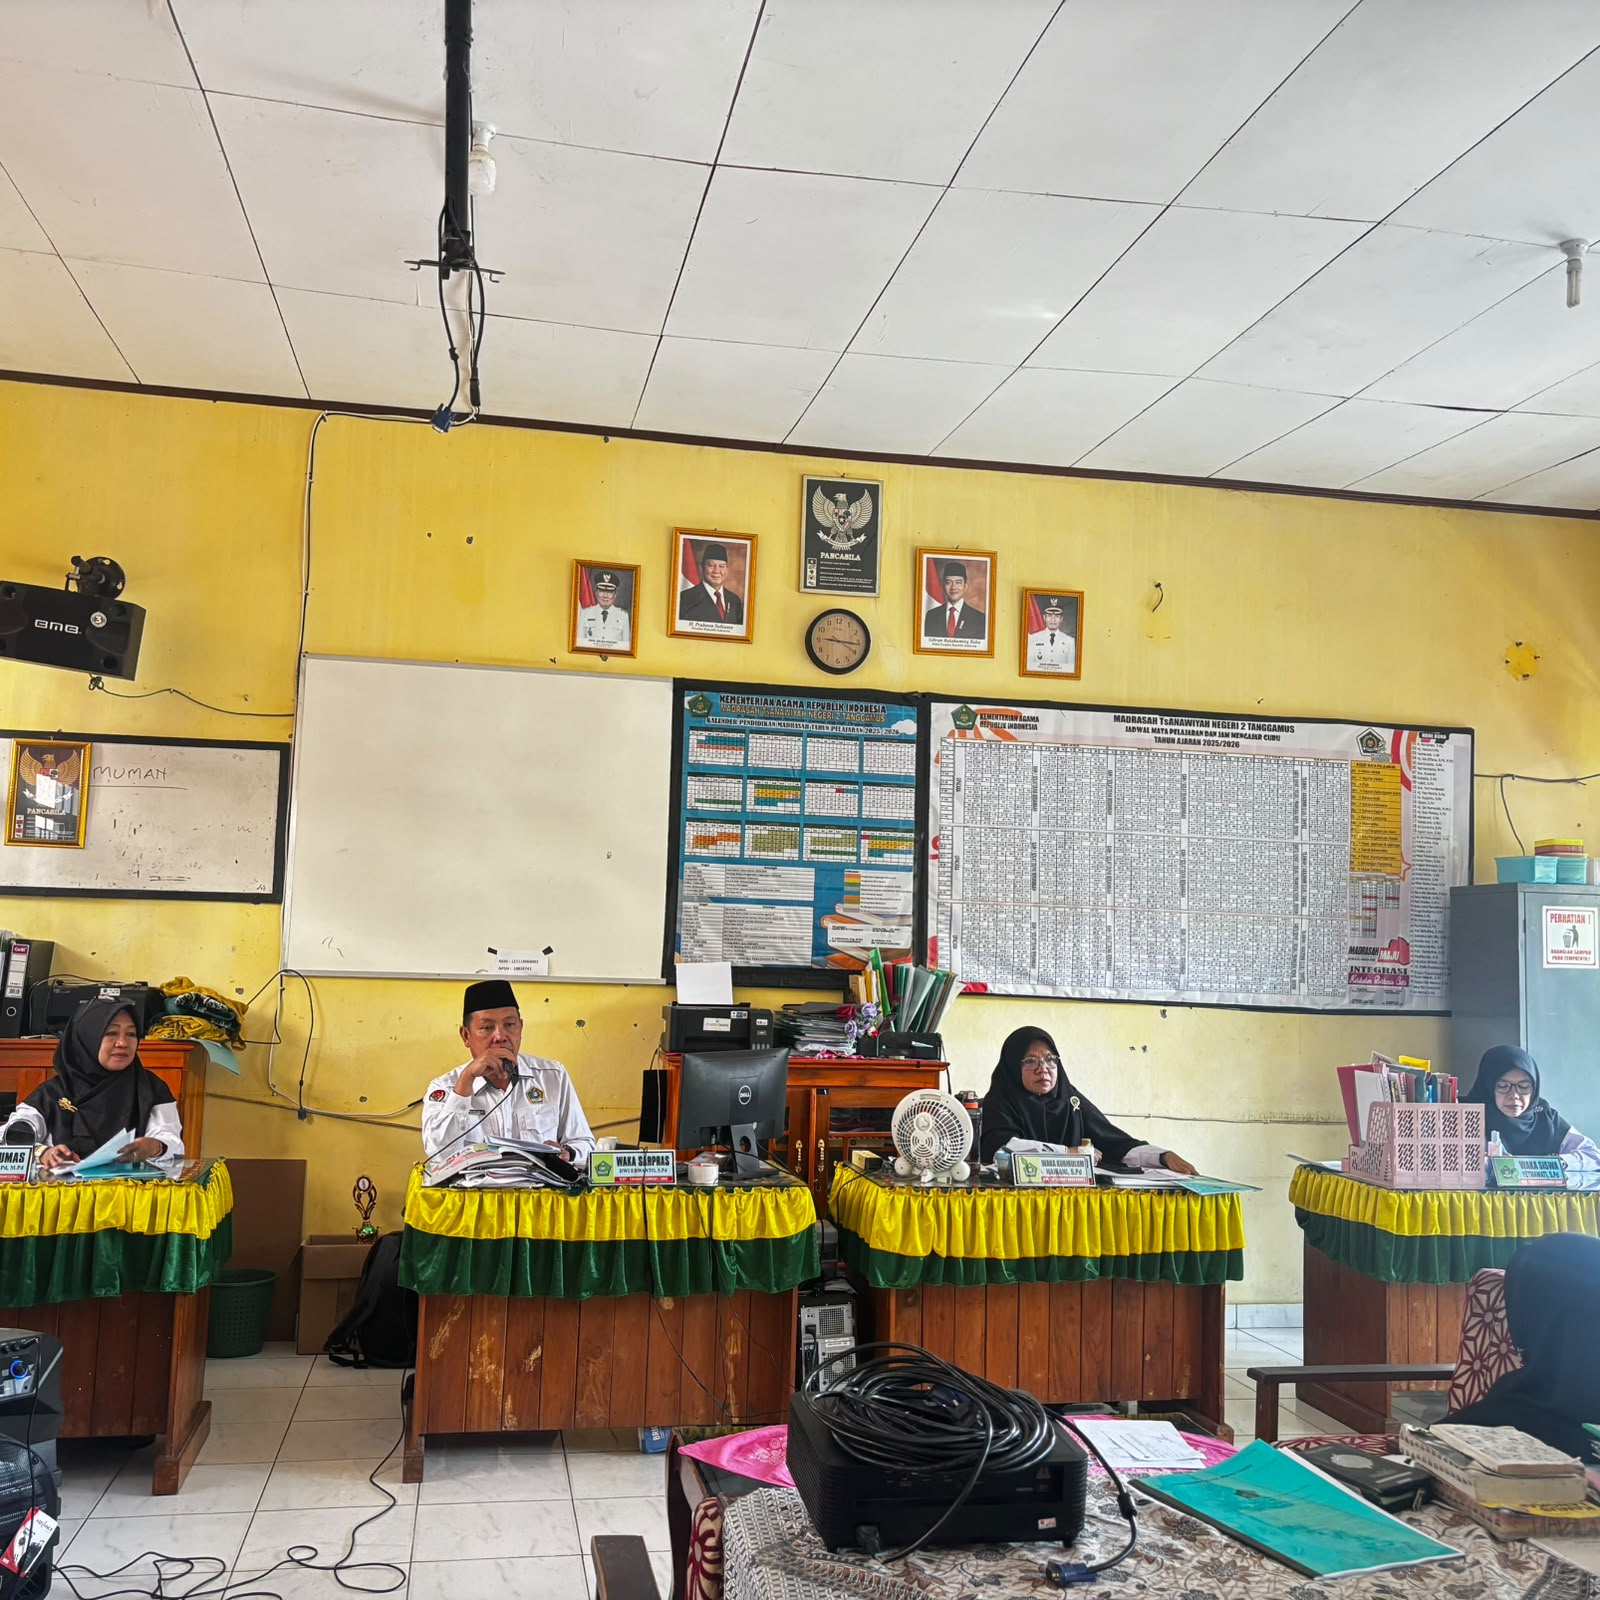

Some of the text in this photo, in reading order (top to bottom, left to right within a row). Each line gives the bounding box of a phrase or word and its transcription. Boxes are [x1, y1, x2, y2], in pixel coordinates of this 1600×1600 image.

[820, 551, 861, 561] PANCASILA
[719, 694, 886, 714] KEMENTERIAN AGAMA REPUBLIK INDONESIA
[720, 704, 760, 715] MADRASAH
[808, 710, 834, 720] NEGERI
[836, 712, 841, 720] 2
[842, 712, 886, 722] TANGGAMUS
[979, 713, 1040, 723] KEMENTERIAN AGAMA
[706, 717, 738, 726] KALENDER
[738, 719, 776, 728] PENDIDIKAN
[864, 728, 900, 736] 2025/2026
[979, 721, 1038, 731] REPUBLIK INDONESIA
[1113, 714, 1158, 725] MADRASAH
[1212, 720, 1240, 730] NEGERI
[1240, 722, 1246, 730] 2
[1248, 722, 1295, 734] TANGGAMUS
[1125, 726, 1150, 734] JADWAL
[1169, 728, 1204, 736] PELAJARAN
[1204, 730, 1217, 738] DAN
[1230, 732, 1262, 740] MENGAJAR
[1264, 734, 1280, 742] GURU
[1154, 736, 1240, 748] TAHUN AJARAN 2025/2026
[1550, 913, 1586, 924] PERHATIAN
[1348, 946, 1379, 956] MADRASAH
[1350, 965, 1408, 975] INTEGRASI
[616, 1156, 670, 1167] WAKA SARPRAS
